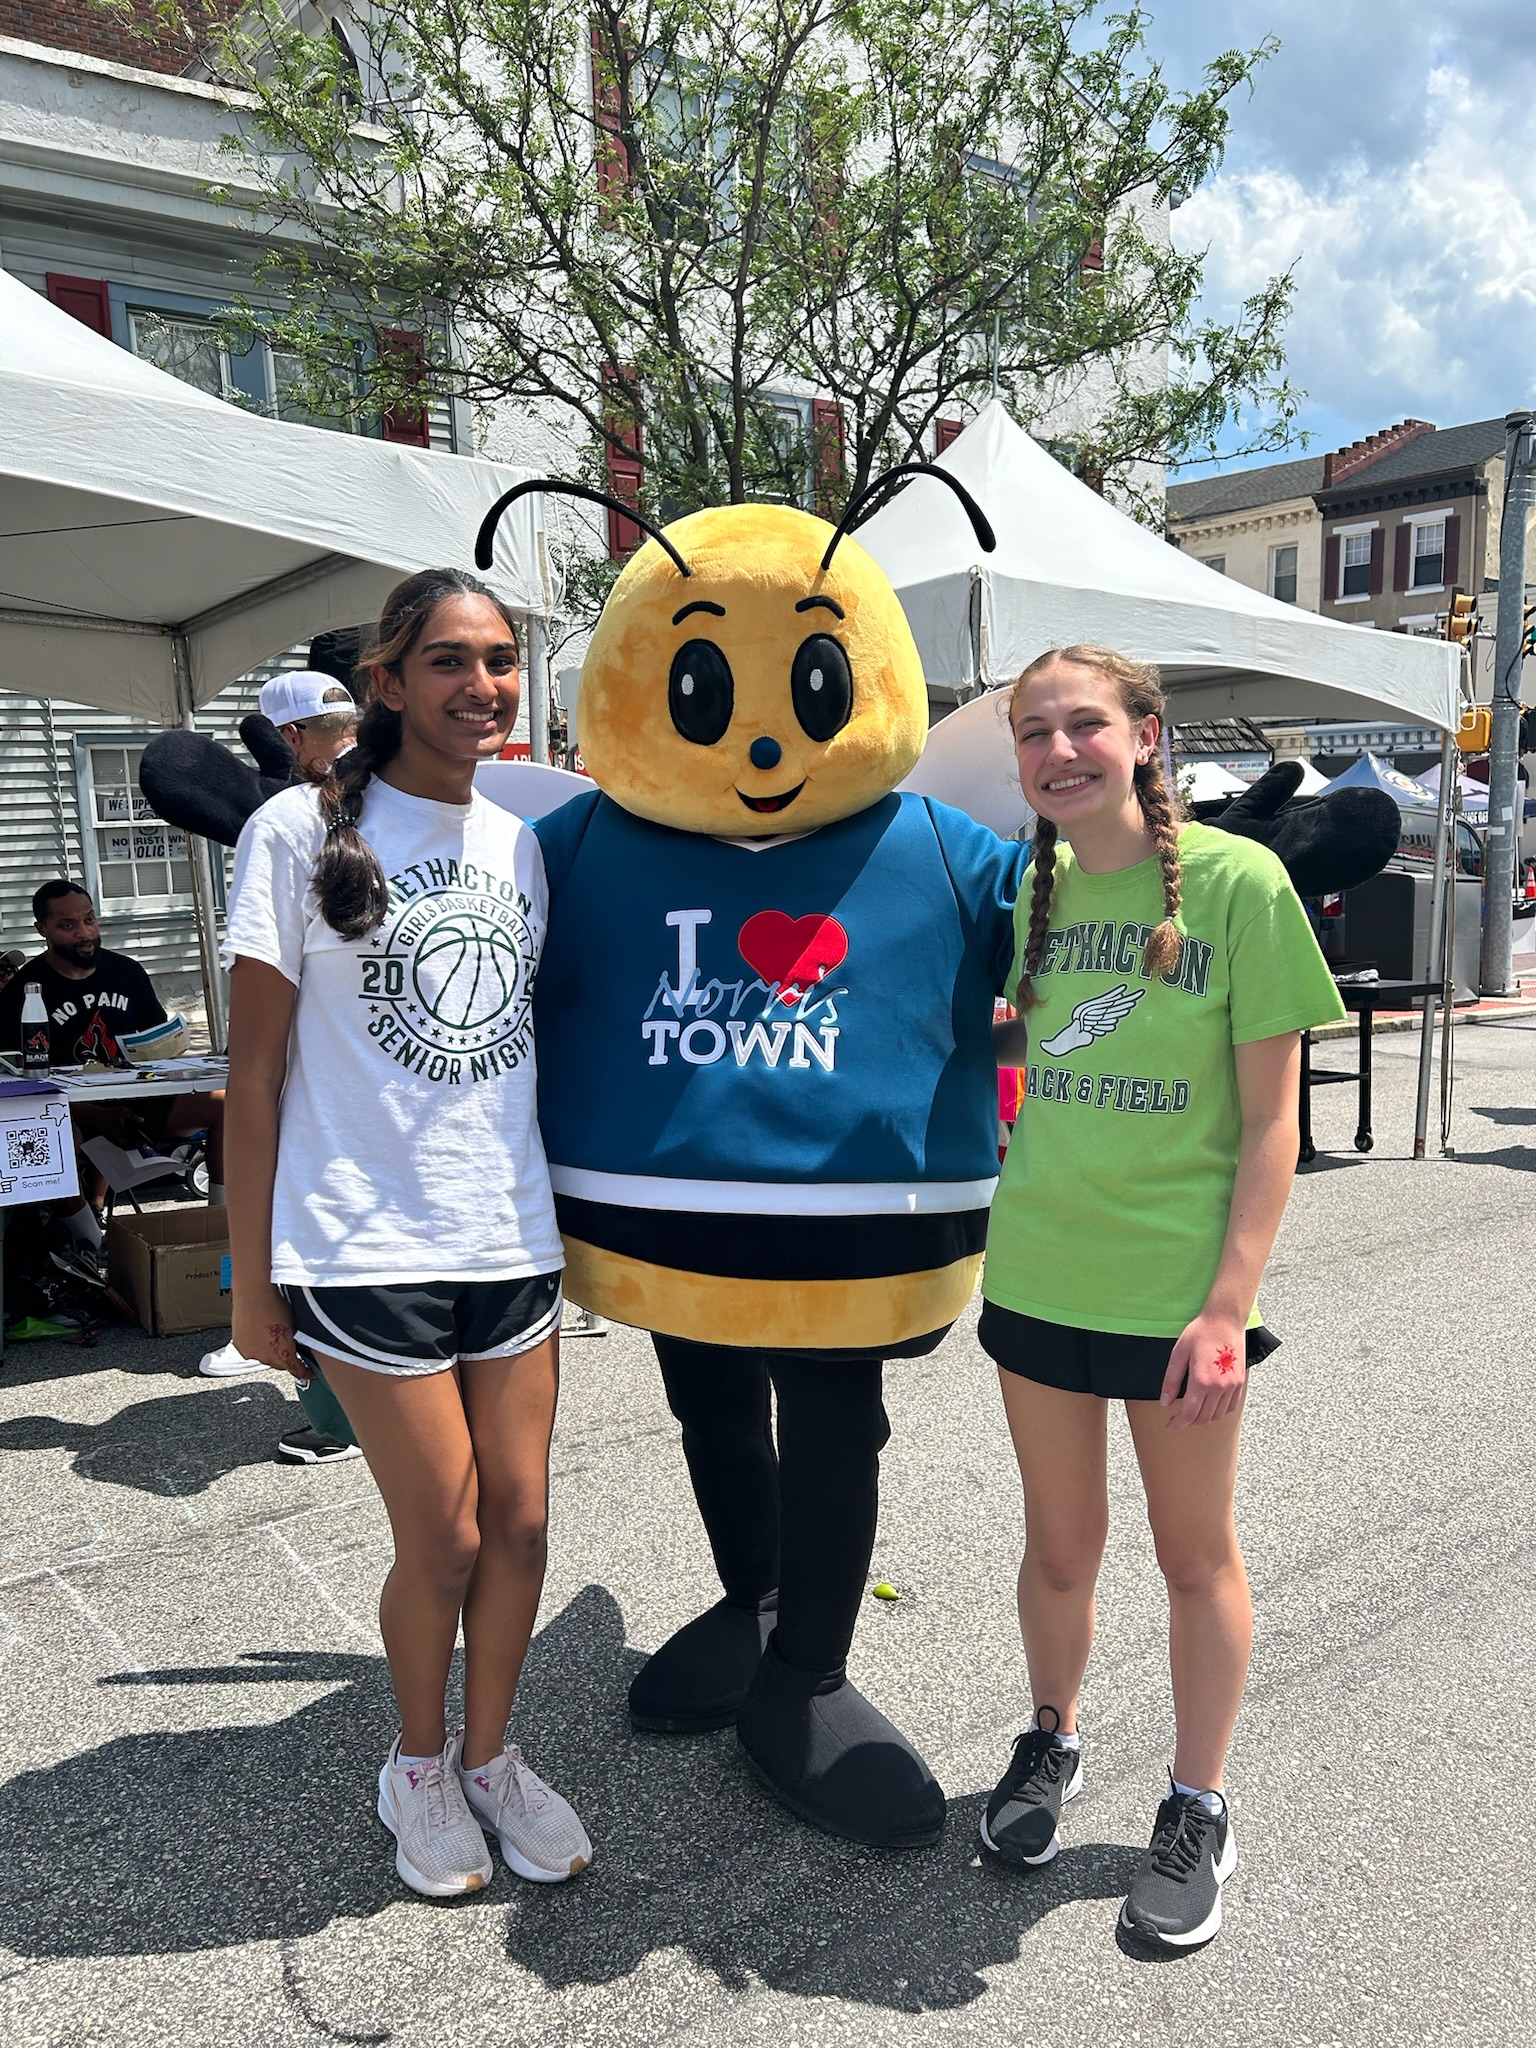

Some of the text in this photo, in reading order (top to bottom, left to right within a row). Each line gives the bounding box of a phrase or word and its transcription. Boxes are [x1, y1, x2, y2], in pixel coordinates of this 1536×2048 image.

[109, 799, 123, 811] WE
[386, 858, 532, 918] METHACTON
[397, 897, 530, 948] GIRLS BASKETBALL
[362, 960, 405, 995] 20
[662, 909, 713, 1006] I
[51, 992, 129, 1026] NO PAIN
[643, 966, 849, 1025] Norris
[367, 1013, 535, 1085] SENIOR NIGHT
[642, 1019, 840, 1072] TOWN
[1075, 1074, 1094, 1104] &
[1095, 1074, 1191, 1114] FIELD
[22, 1177, 61, 1189] Scan me!
[185, 1270, 213, 1280] Product
